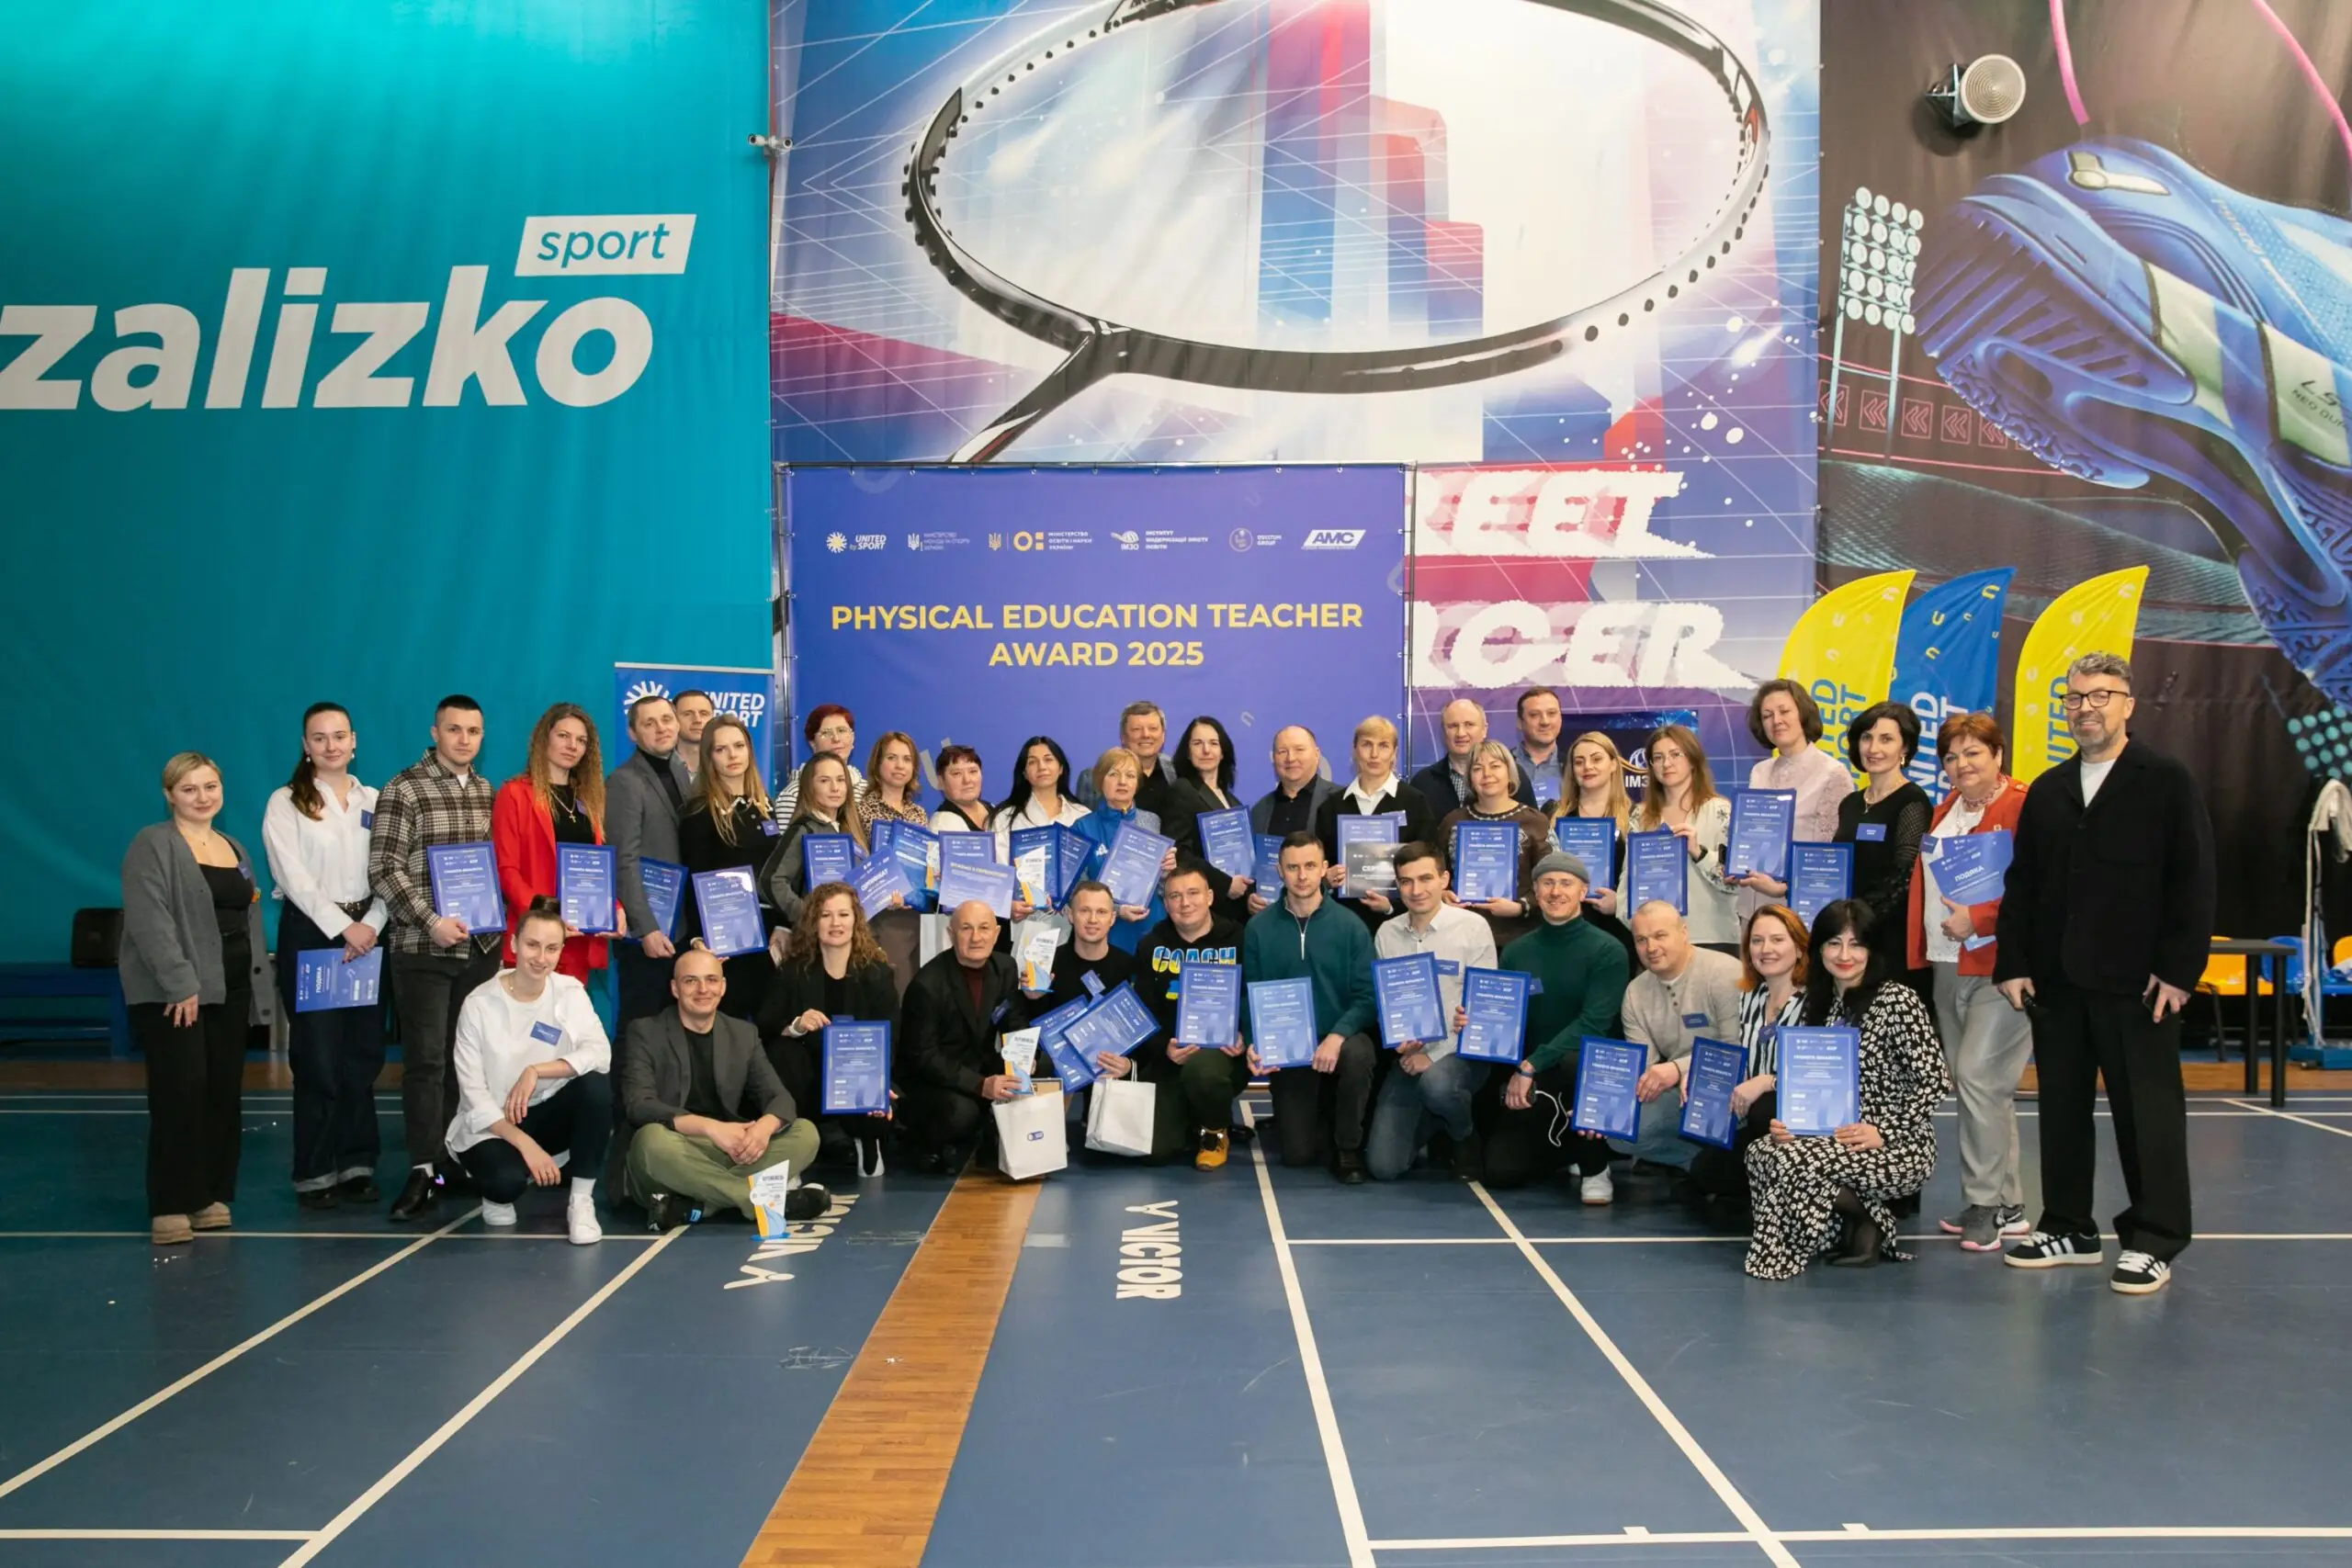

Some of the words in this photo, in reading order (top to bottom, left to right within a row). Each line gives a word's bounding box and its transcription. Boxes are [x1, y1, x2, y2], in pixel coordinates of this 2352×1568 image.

[537, 221, 671, 268] sport
[0, 265, 653, 412] zalizko
[855, 535, 887, 543] UNITED
[857, 542, 886, 550] SPORT
[1312, 532, 1354, 544] AMC
[831, 604, 993, 629] PHYSICAL
[1002, 603, 1198, 629] EDUCATION
[1206, 603, 1363, 628] TEACHER
[988, 641, 1118, 667] AWARD
[1127, 640, 1204, 666] 2025
[705, 691, 765, 710] NITED
[2046, 676, 2074, 764] ITED
[1908, 692, 1939, 798] NIED
[1151, 945, 1237, 975] COACH
[1116, 1220, 1183, 1300] VICTOR
